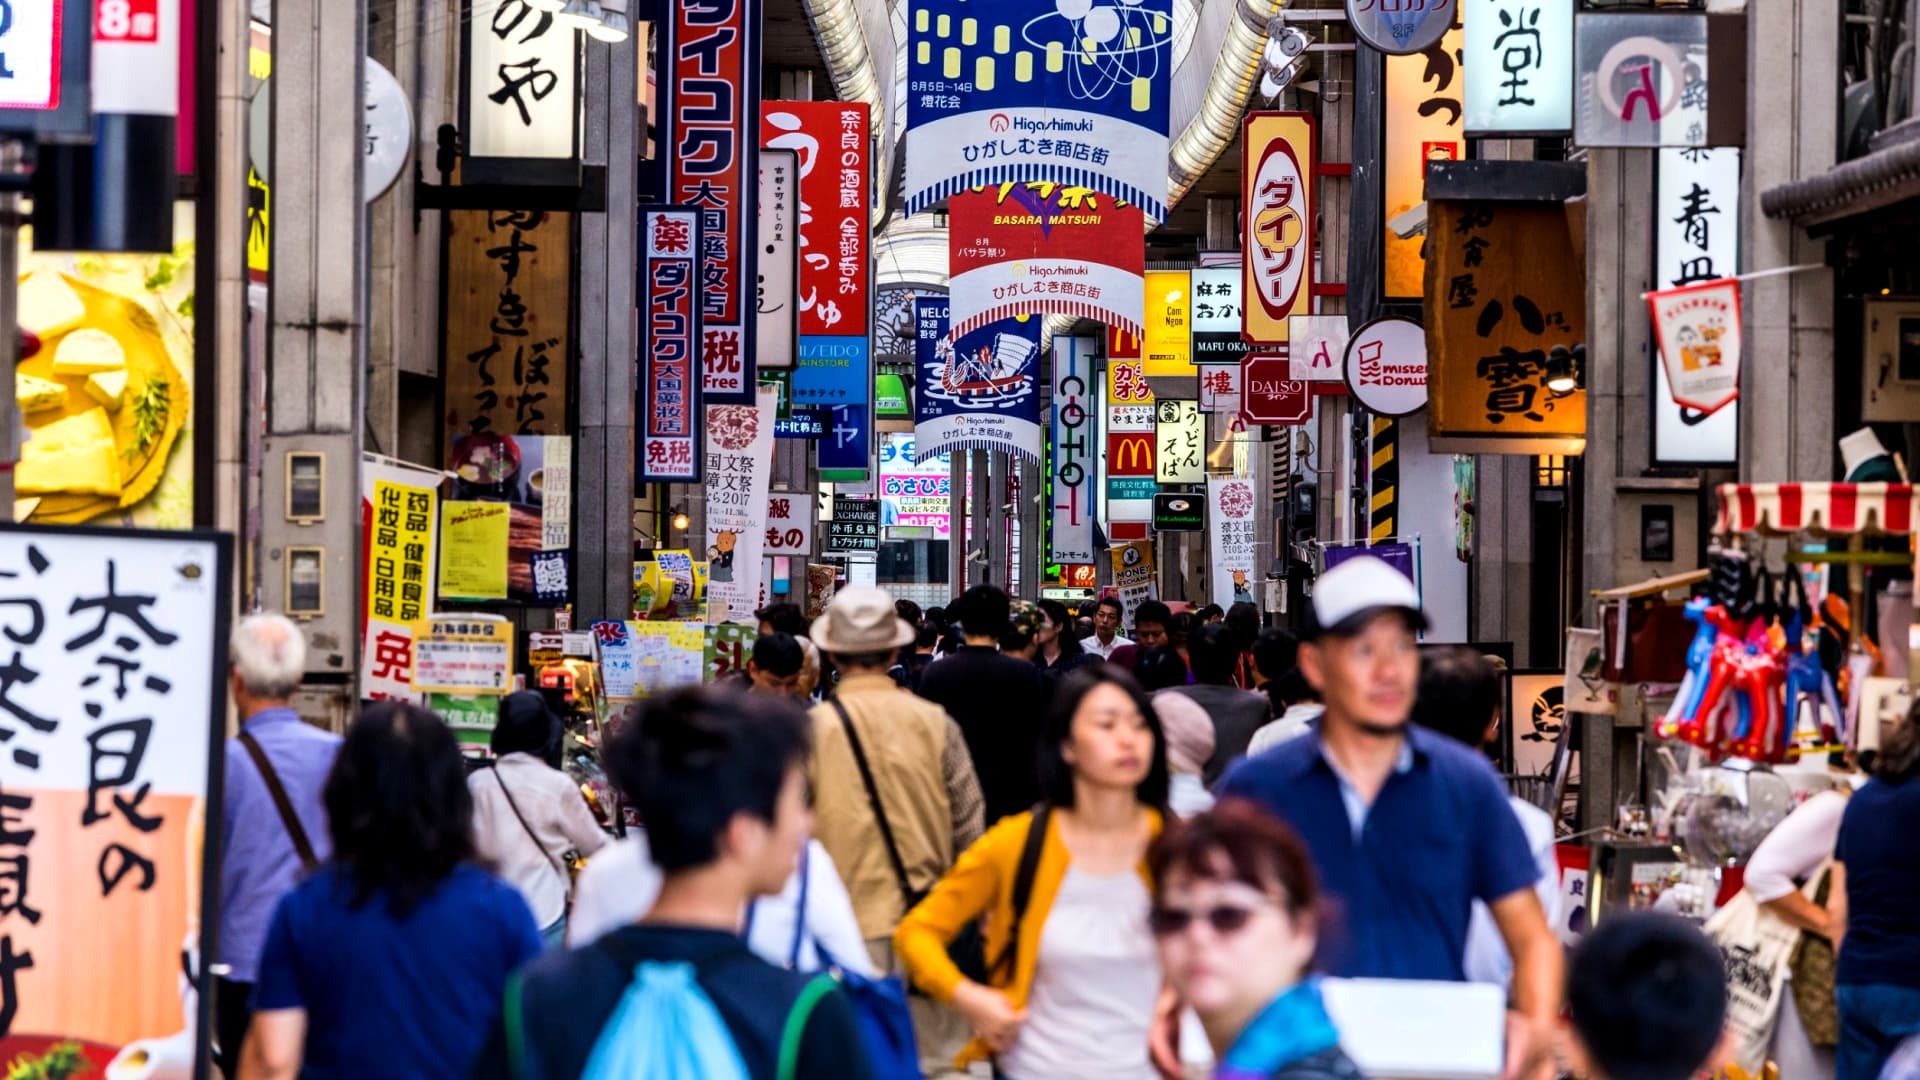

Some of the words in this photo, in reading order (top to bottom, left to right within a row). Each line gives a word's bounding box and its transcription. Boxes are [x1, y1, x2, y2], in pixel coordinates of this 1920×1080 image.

[1392, 24, 1415, 38] 2F
[1493, 6, 1542, 107] 堂
[920, 95, 961, 108] 燈花会
[1013, 117, 1093, 134] Higashimuki
[839, 110, 861, 209] 奈良の酒蔵
[962, 138, 1109, 166] ひがしむき商店街
[993, 215, 1043, 225] BASARA
[1048, 215, 1101, 225] MATSURI
[654, 213, 690, 254] 薬
[1259, 175, 1296, 299] ダイソー
[958, 248, 1006, 258] バサラ祭り
[1028, 263, 1088, 279] Higashimuki
[992, 281, 1102, 300] ひがしむき商店街
[1196, 281, 1232, 297] 麻布
[653, 260, 691, 363] ダイコク
[920, 307, 949, 319] WELC
[1197, 342, 1225, 352] MAFU
[1227, 342, 1250, 352] OKA
[703, 374, 739, 389] Free
[1250, 380, 1302, 393] DAISO
[966, 416, 1005, 427] Higashimuki
[942, 427, 1013, 440] ひがしむき商店街
[1182, 406, 1200, 468] うどん
[647, 440, 691, 465] 免税
[1162, 438, 1181, 477] そば
[649, 465, 690, 474] Tax-Free
[706, 453, 754, 474] 国文祭
[769, 498, 790, 520] 級
[834, 502, 871, 512] MONE
[763, 527, 804, 549] もの
[1055, 551, 1089, 559] コトモール
[1116, 564, 1151, 579] MONEY
[674, 583, 690, 596] EX
[591, 622, 625, 641] 氷
[65, 559, 179, 896] 奈良の
